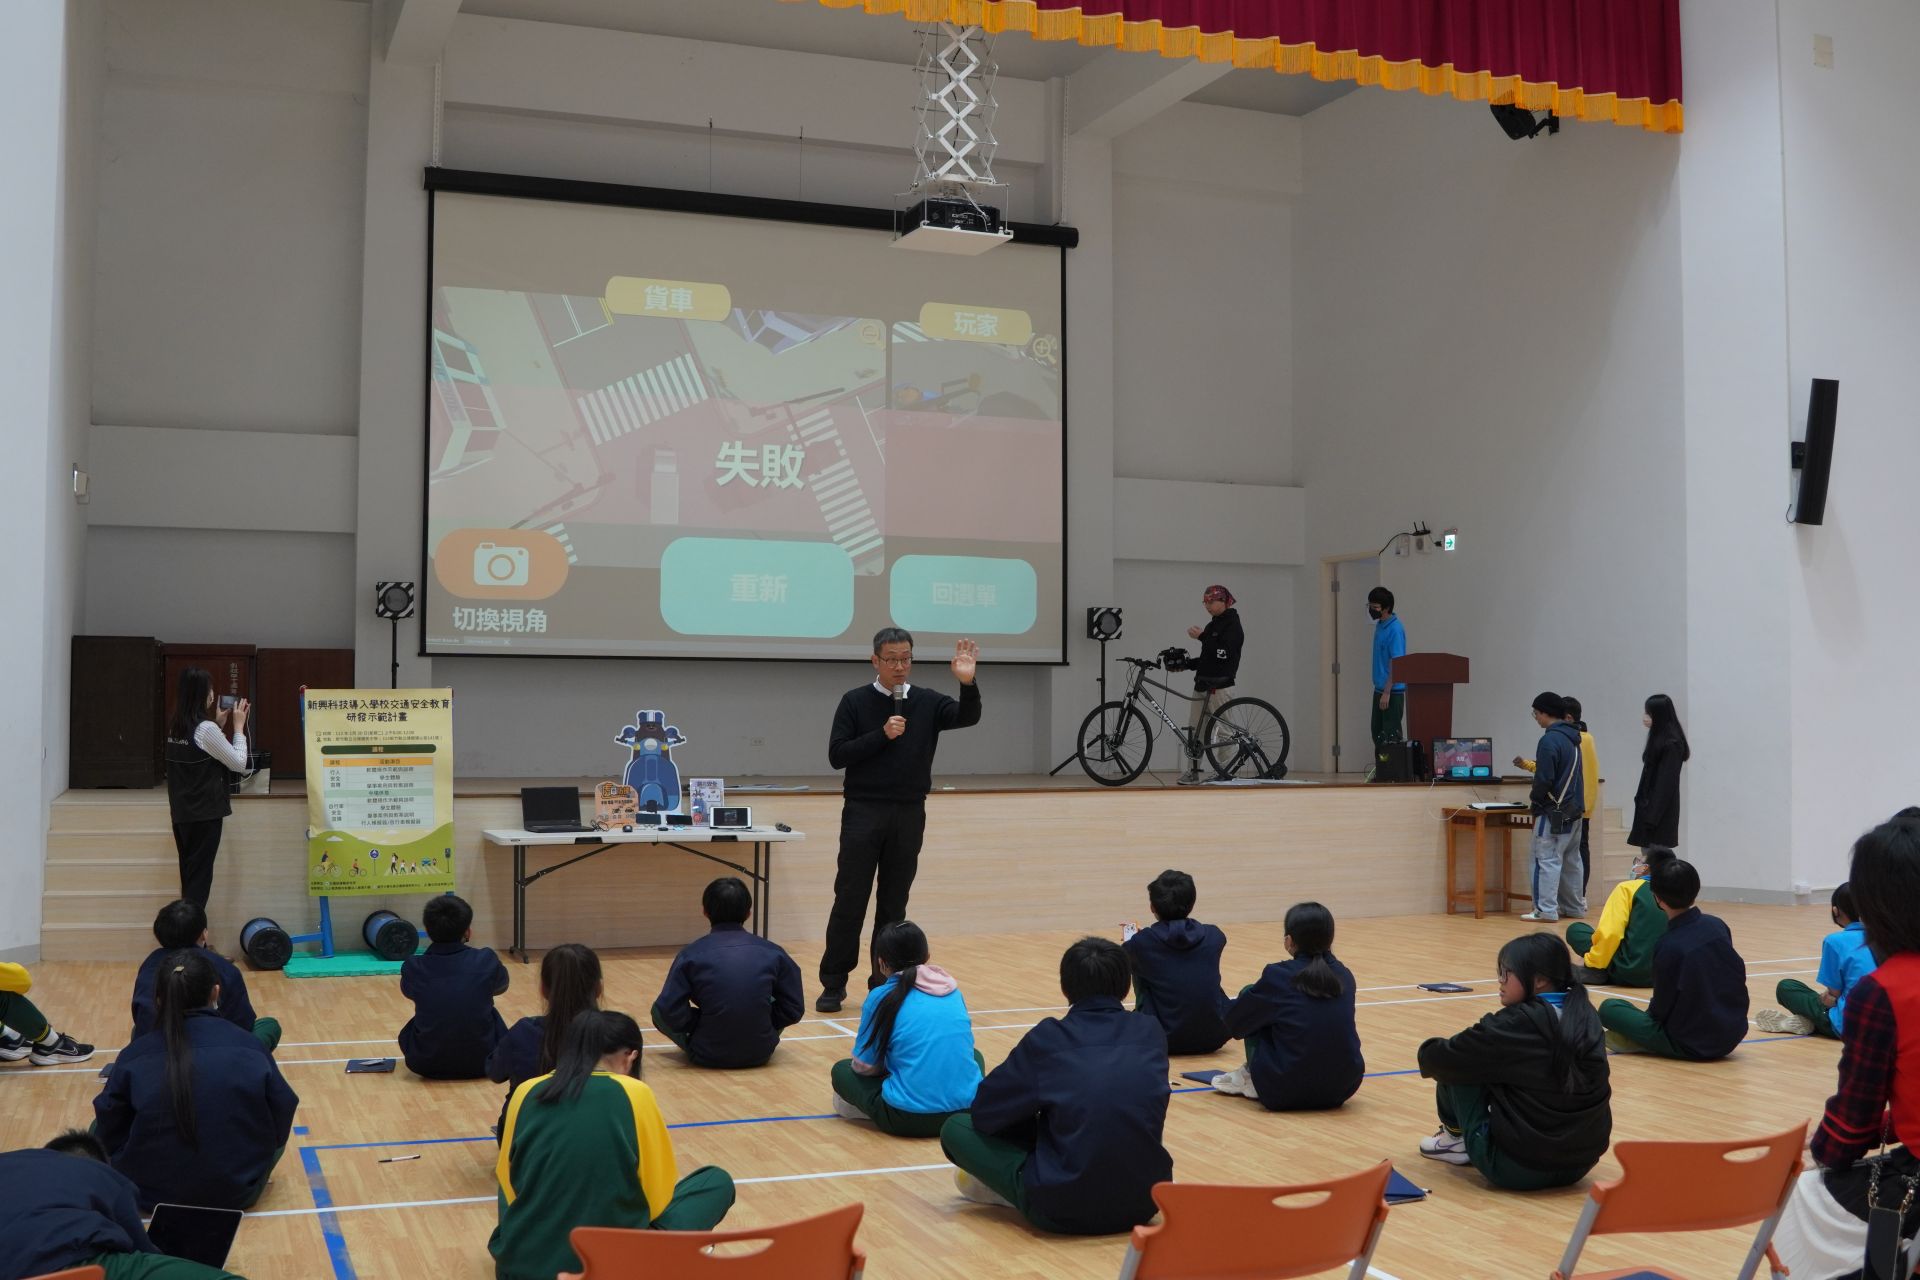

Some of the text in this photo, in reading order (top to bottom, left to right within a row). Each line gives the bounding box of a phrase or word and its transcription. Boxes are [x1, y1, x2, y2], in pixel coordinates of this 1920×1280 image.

[644, 285, 694, 312] 貨車
[954, 311, 998, 336] 玩家
[715, 440, 805, 488] 失敗
[730, 574, 788, 602] 重新
[932, 582, 997, 607] 回選單
[452, 606, 548, 632] 切換視角
[307, 699, 450, 710] 新興科技導入學校交通安全教育
[346, 712, 408, 722] 研發示範計畫
